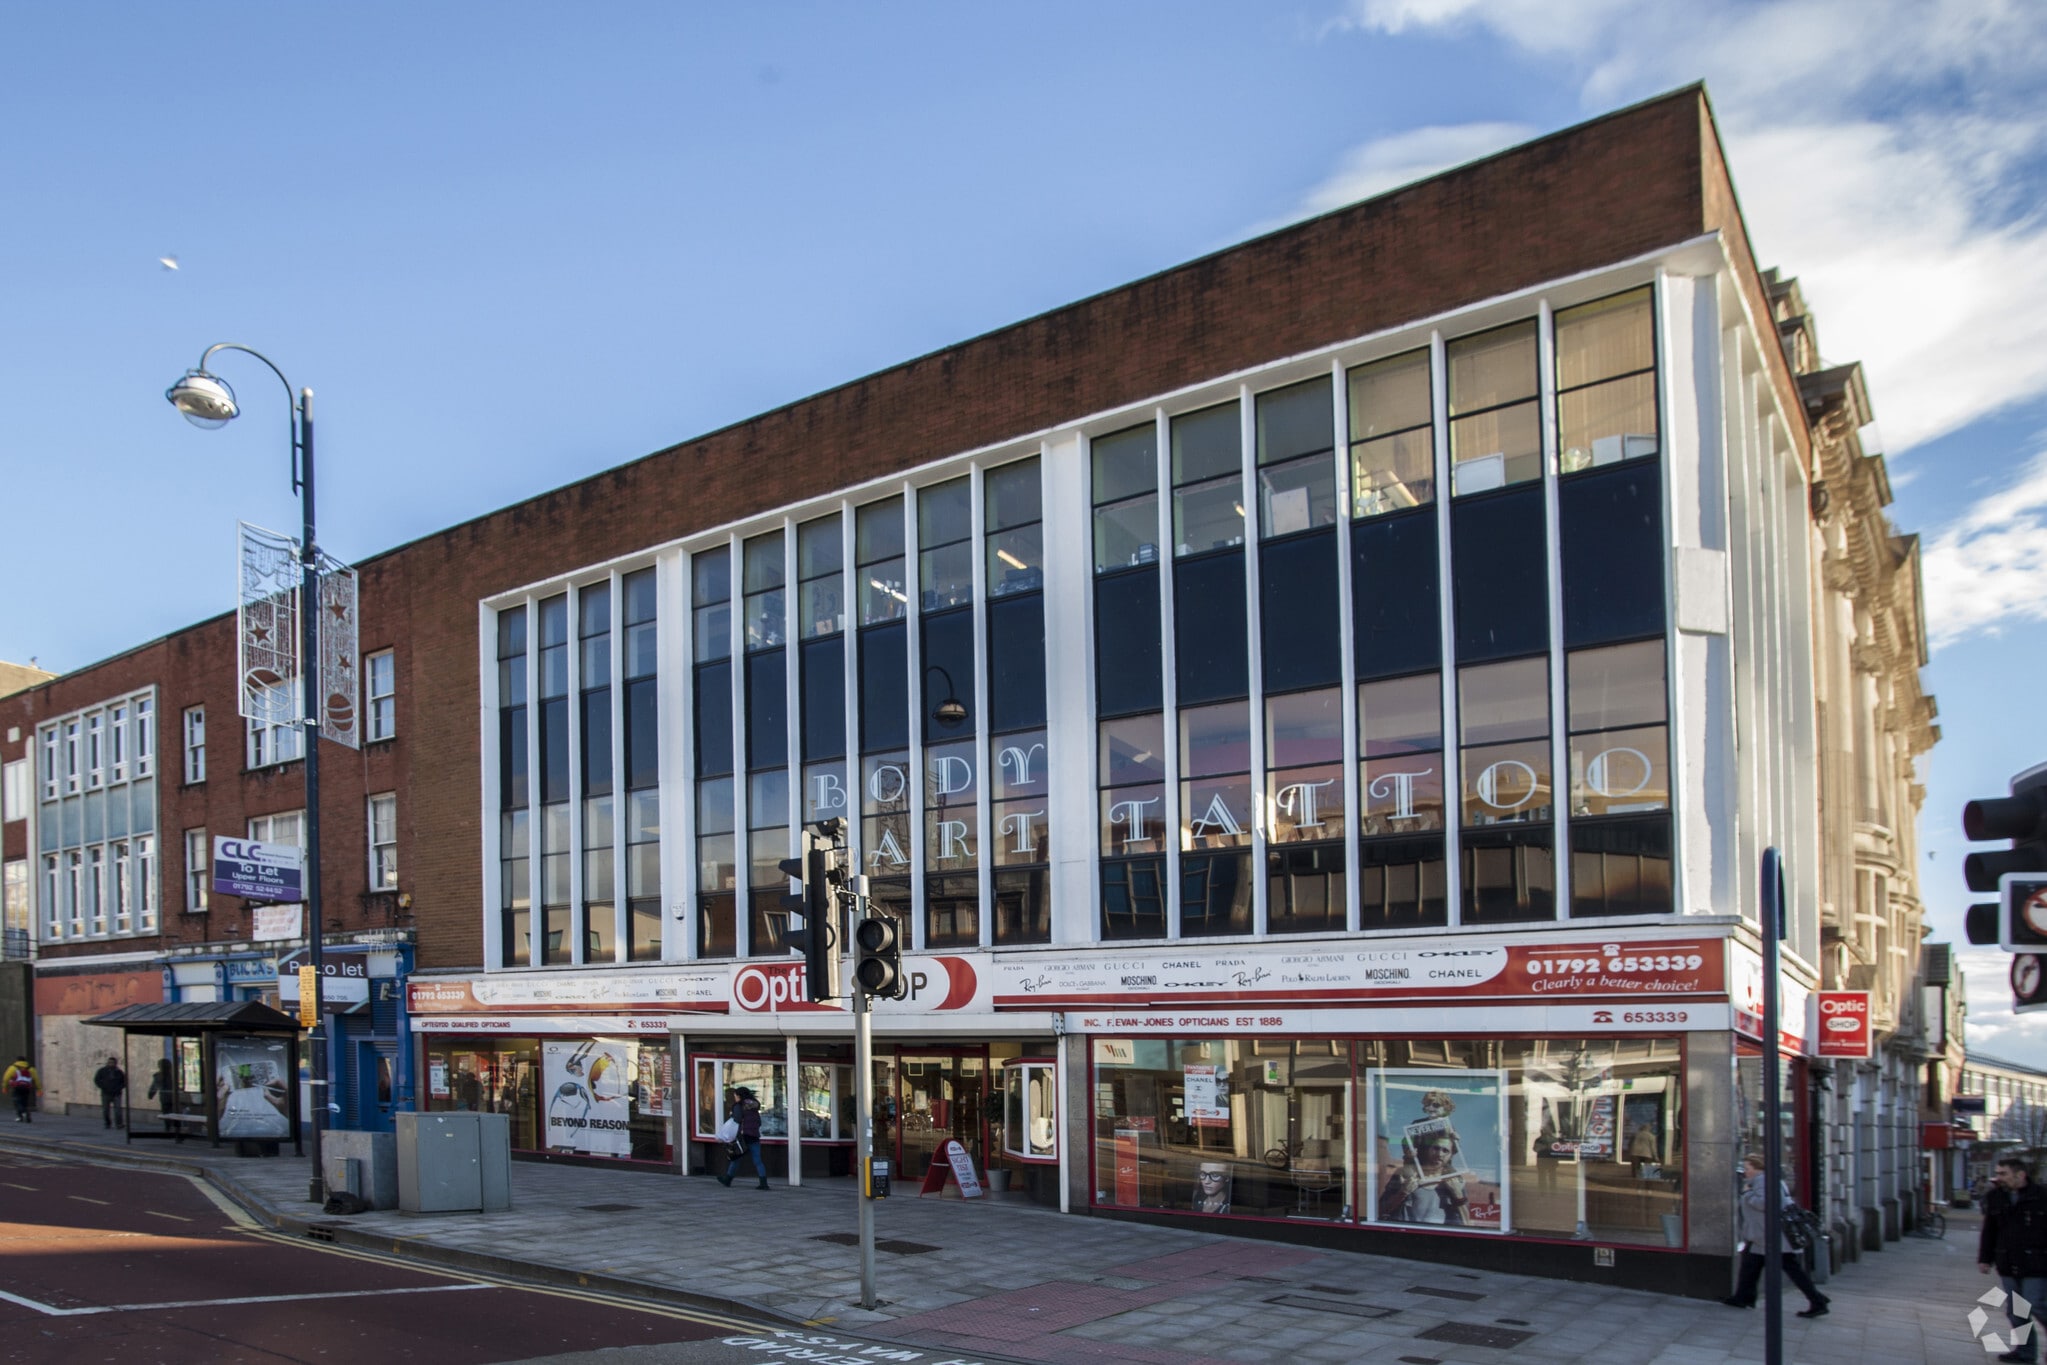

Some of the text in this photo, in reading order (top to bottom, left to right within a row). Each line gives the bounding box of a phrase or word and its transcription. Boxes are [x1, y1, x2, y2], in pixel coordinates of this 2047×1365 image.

[813, 742, 1045, 811] BODY
[869, 746, 1653, 867] ART TATTOO
[221, 841, 261, 862] CLC
[238, 862, 279, 877] To Let
[232, 871, 284, 885] Upper Floors
[341, 961, 365, 977] let
[1104, 961, 1146, 971] GUCCI
[1162, 960, 1203, 970] CHANEL
[1215, 959, 1247, 967] PRADA
[1356, 952, 1408, 962] GUCCI
[1526, 954, 1703, 975] 01792 653339
[768, 966, 788, 975] The
[1120, 975, 1158, 987] MOSCHINO
[1365, 967, 1410, 980] MOSCHINO
[1428, 968, 1483, 979] CHANEL
[736, 965, 808, 1012] Opti
[1531, 974, 1699, 993] Clearly a better choice!
[686, 989, 713, 997] CHANEL
[1820, 1000, 1866, 1015] Optic
[450, 1020, 480, 1029] QUALIFIED
[481, 1020, 512, 1029] OPTICIANS
[1083, 1018, 1102, 1027] INC.
[1178, 1016, 1230, 1027] OPTICIANS
[1235, 1017, 1255, 1026] EST
[1259, 1016, 1284, 1026] 1886
[1623, 1011, 1689, 1023] 653339
[1829, 1020, 1859, 1029] SHOP
[640, 1020, 668, 1030] 653339
[1185, 1076, 1214, 1084] CHANEL
[550, 1116, 630, 1131] BEYOND REASON
